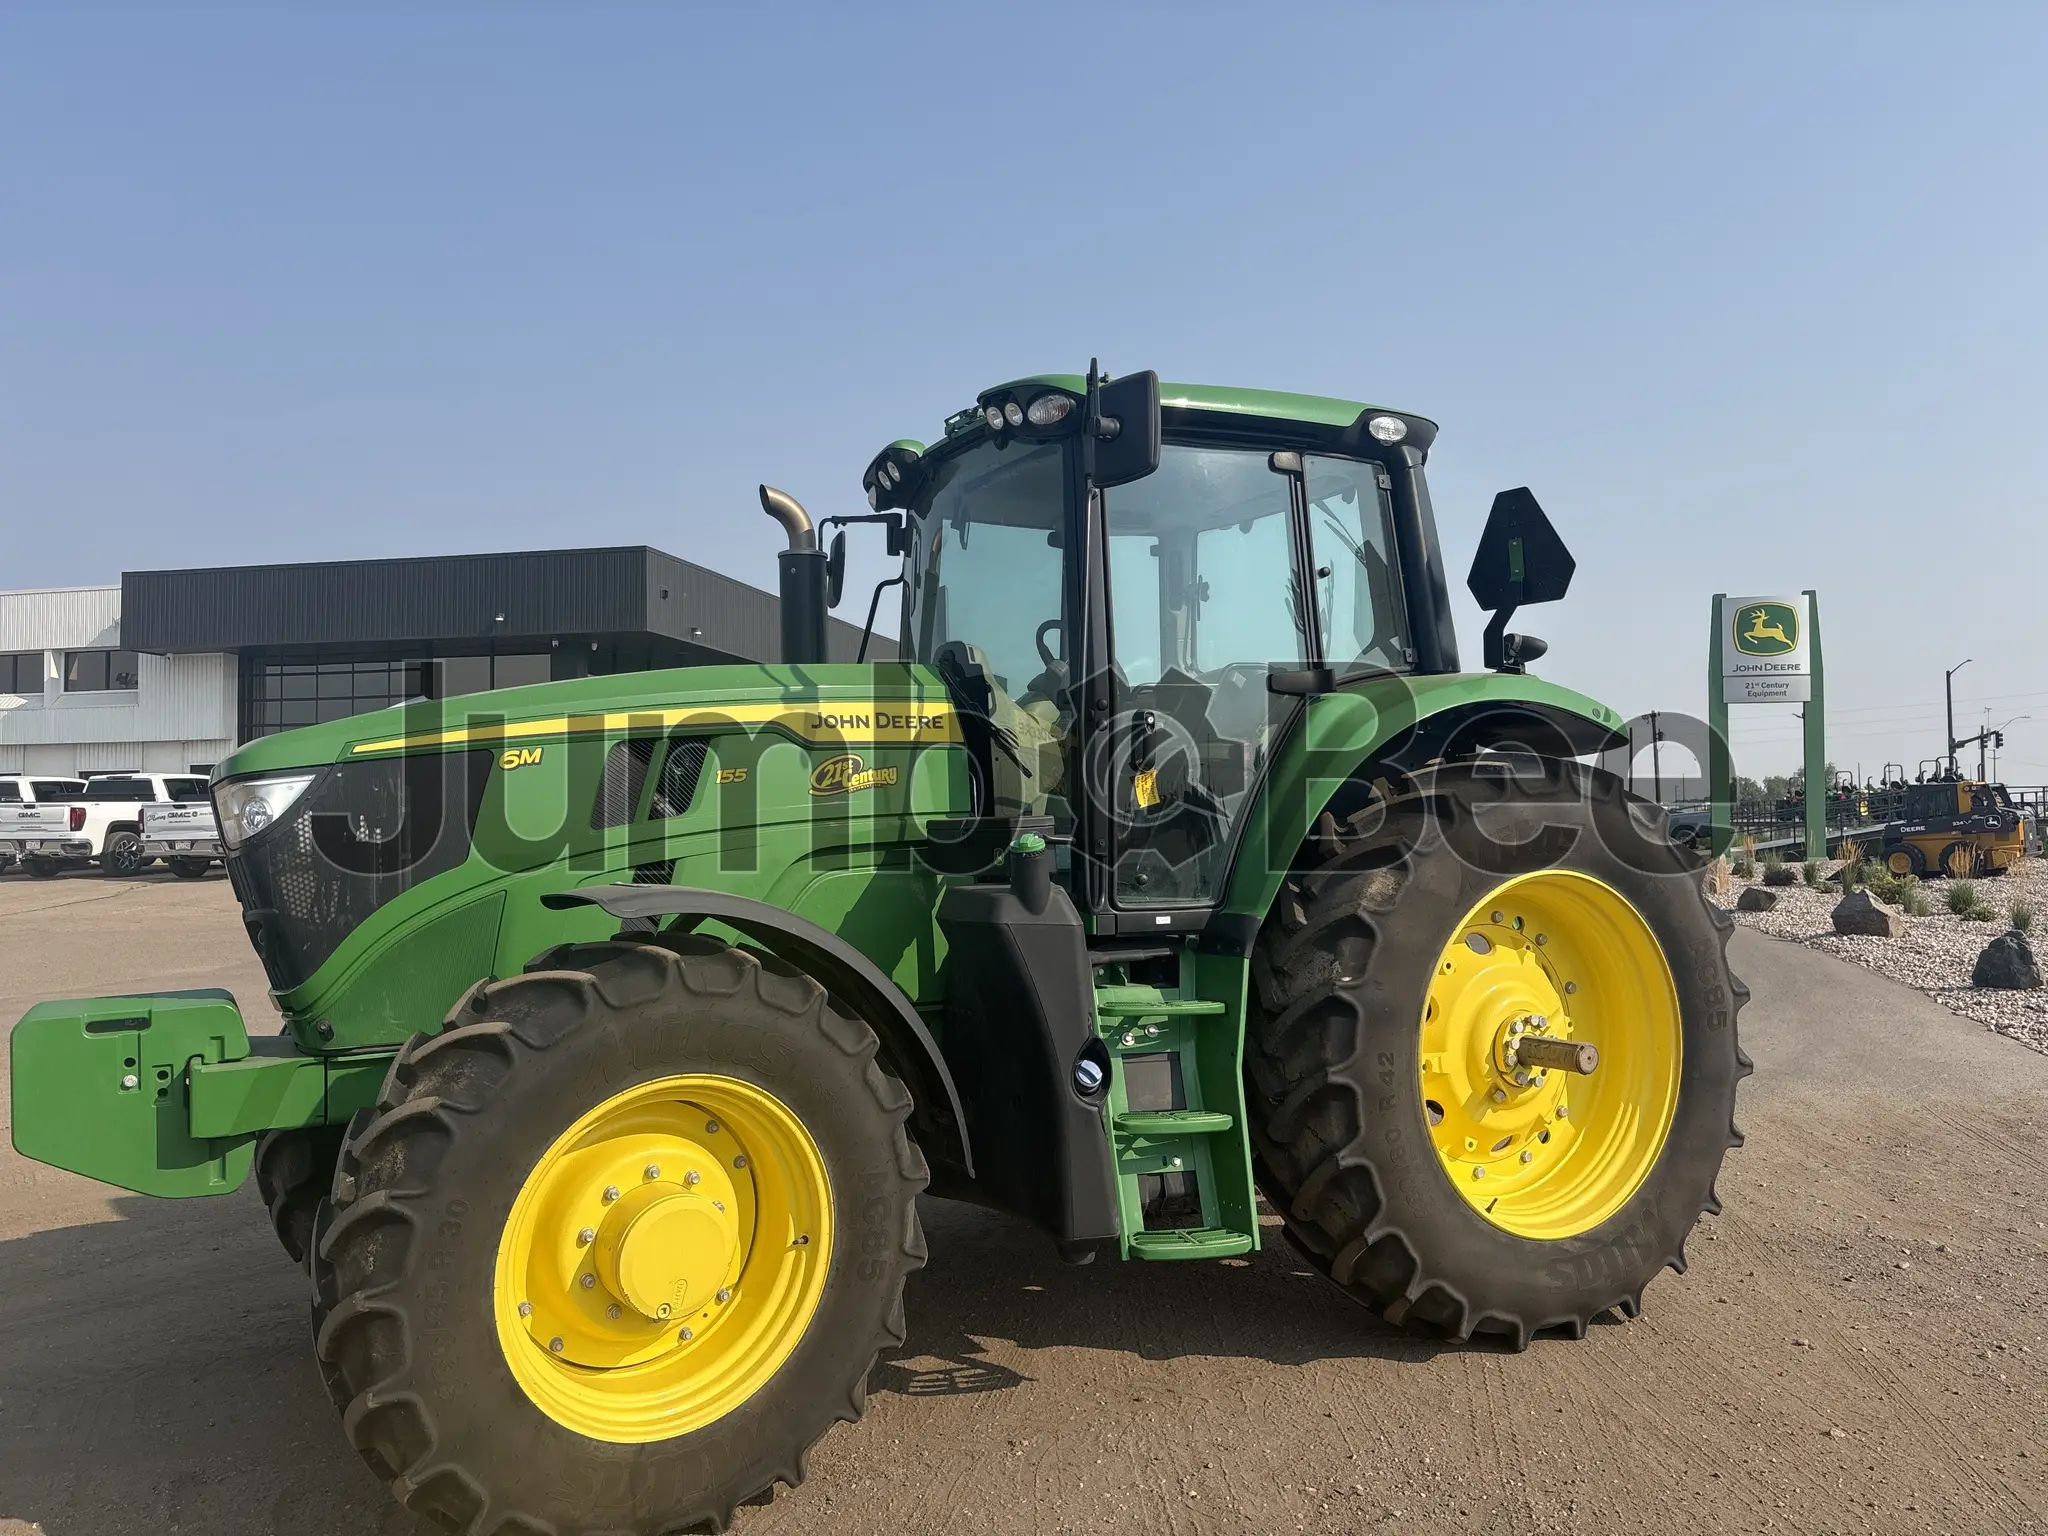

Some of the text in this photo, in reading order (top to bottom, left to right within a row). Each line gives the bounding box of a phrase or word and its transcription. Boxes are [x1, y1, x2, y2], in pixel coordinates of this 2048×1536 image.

[1733, 662, 1801, 672] JOHN DEERE
[1761, 681, 1790, 690] Century
[1747, 690, 1788, 698] Equipment
[811, 711, 944, 730] JOHN DEERE
[498, 747, 544, 771] 6M
[715, 768, 748, 785] 155
[1900, 825, 1926, 833] DEERE
